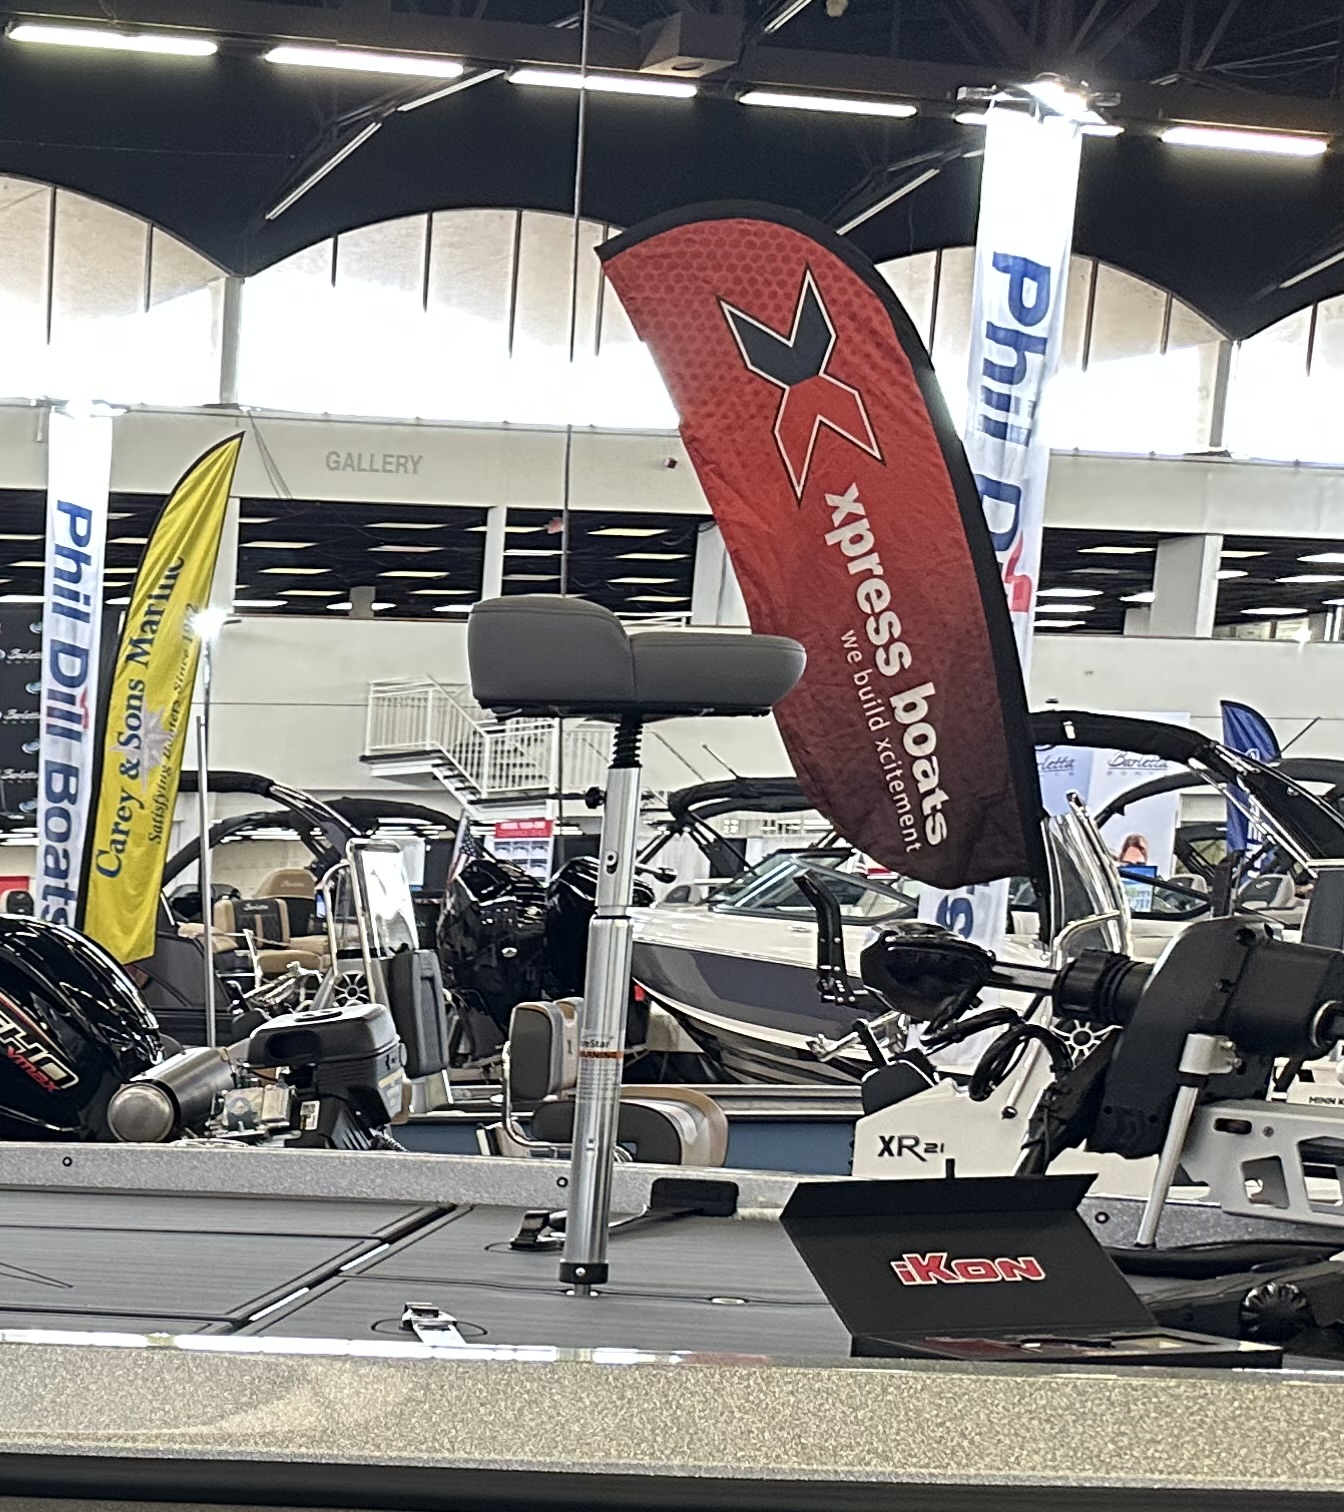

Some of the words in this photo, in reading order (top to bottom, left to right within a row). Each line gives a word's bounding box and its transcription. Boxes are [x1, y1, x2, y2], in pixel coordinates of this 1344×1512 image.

[979, 251, 1050, 448] Phil
[325, 450, 424, 475] GALLERY
[51, 499, 93, 625] Phil
[45, 638, 90, 743] Dill
[117, 678, 146, 750] Sons
[823, 481, 912, 677] xpress
[888, 681, 950, 846] boats
[118, 757, 141, 781] &
[840, 629, 862, 664] we
[853, 668, 889, 732] build
[874, 736, 922, 853] xcitement
[41, 759, 79, 926] Boats
[95, 786, 145, 879] Carey
[148, 764, 173, 845] Satisfying
